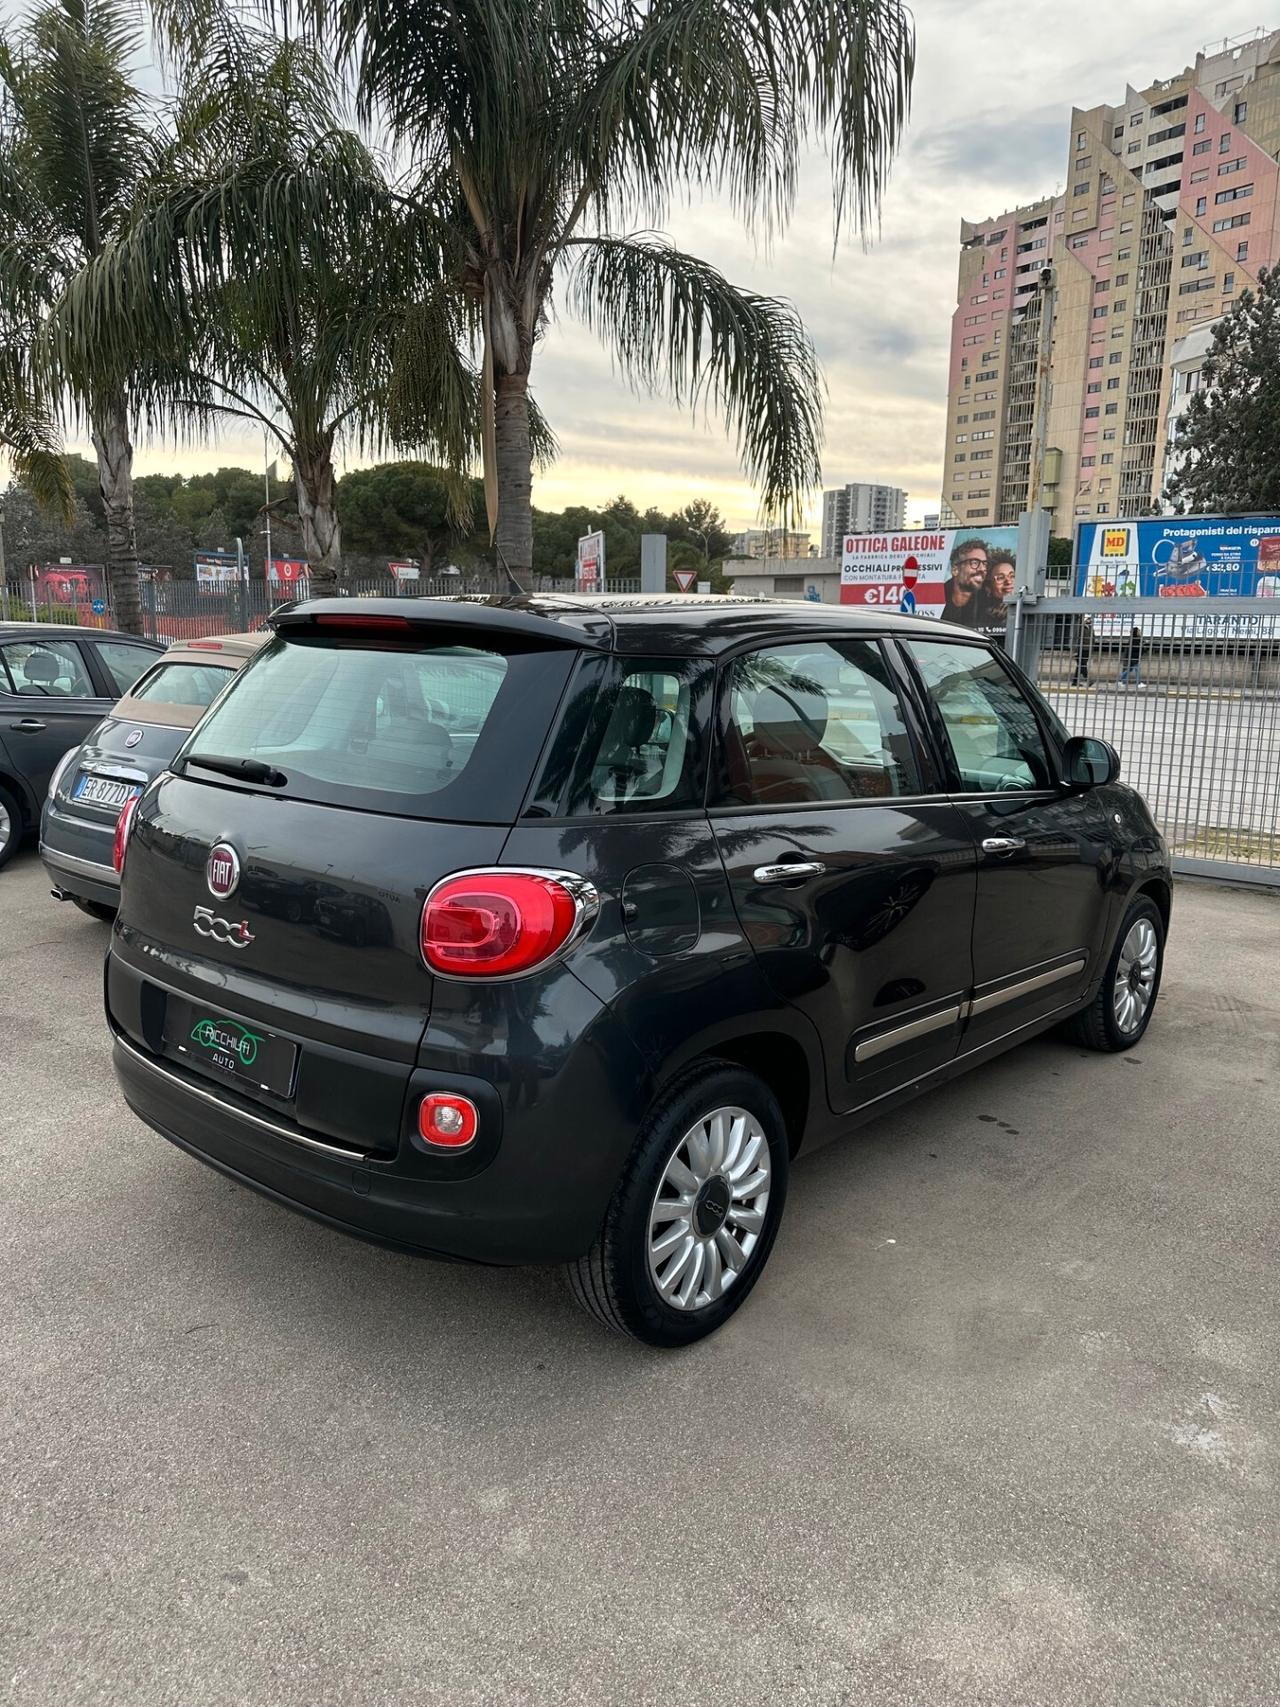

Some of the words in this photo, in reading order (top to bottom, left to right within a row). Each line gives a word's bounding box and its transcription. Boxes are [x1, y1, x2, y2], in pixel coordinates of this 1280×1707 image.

[1163, 526, 1224, 537] Protagonisti
[1226, 527, 1242, 535] del
[846, 538, 888, 553] OTTICA
[891, 535, 945, 552] GALEONE
[1105, 536, 1125, 548] MD
[844, 564, 890, 573] OCCHIALI
[212, 860, 232, 886] FIAT
[212, 1053, 235, 1069] AUTO
